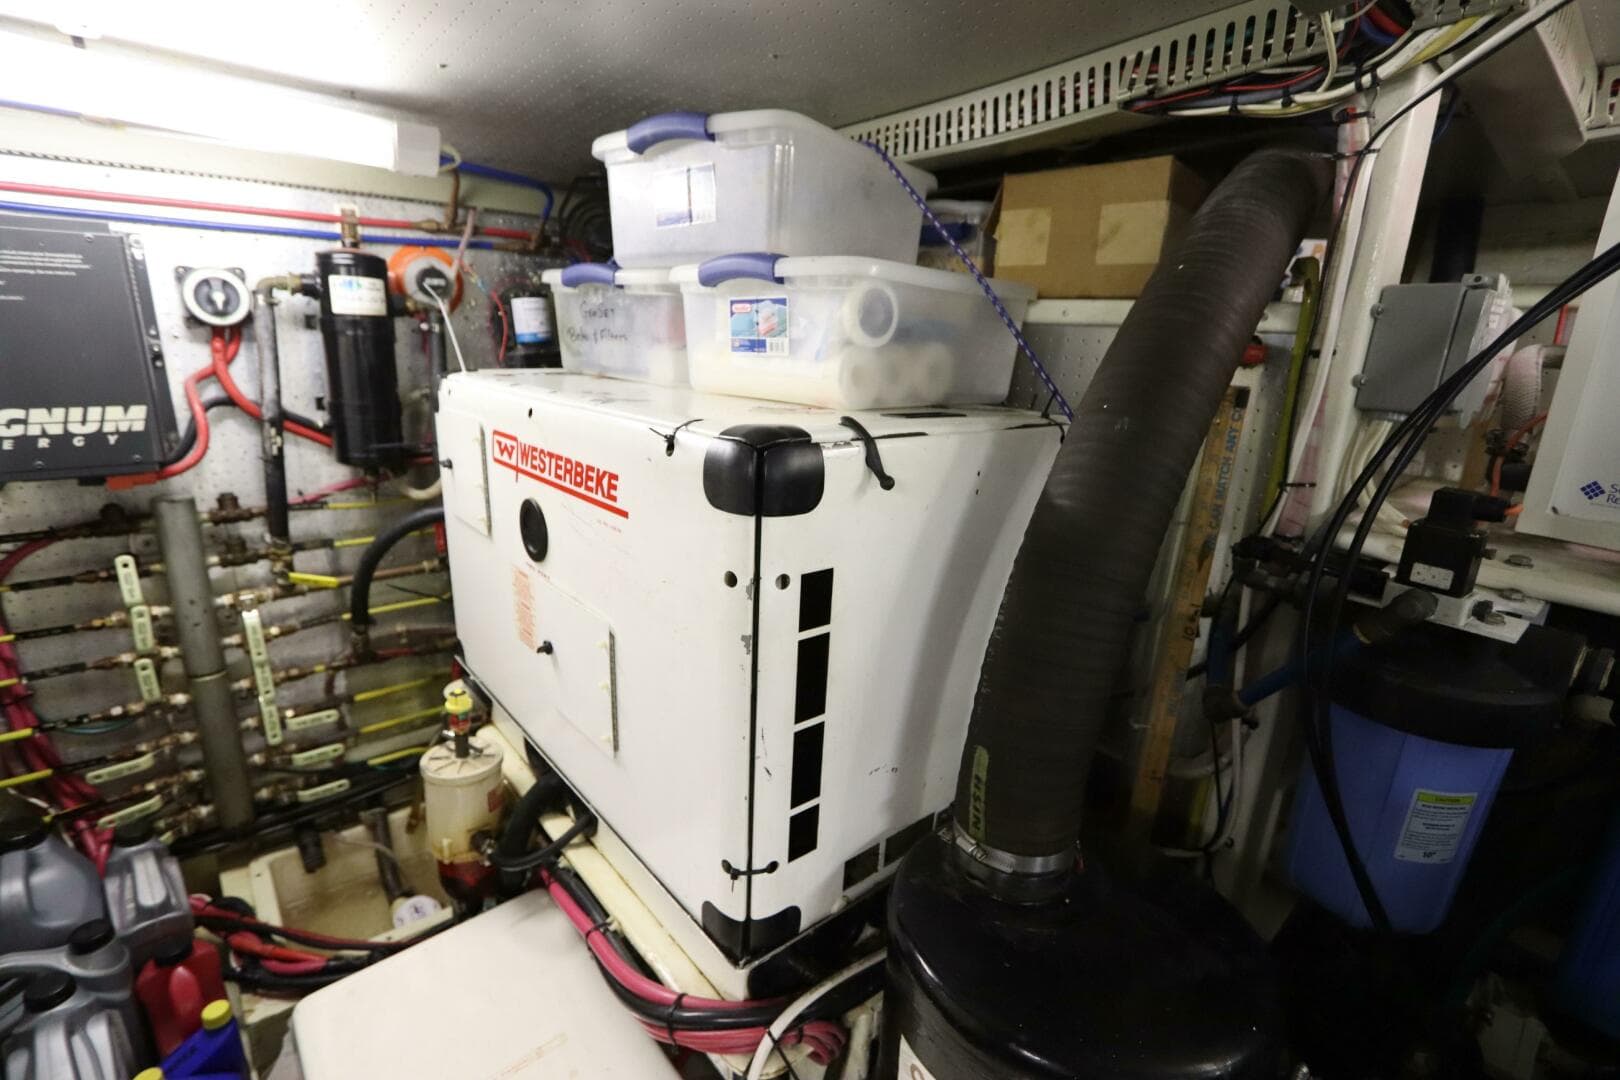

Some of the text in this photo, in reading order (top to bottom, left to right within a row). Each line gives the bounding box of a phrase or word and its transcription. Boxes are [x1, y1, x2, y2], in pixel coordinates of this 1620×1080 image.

[519, 441, 619, 503] WESTERBEKE
[1215, 455, 1233, 500] MATCH
[1225, 427, 1240, 452] ANY
